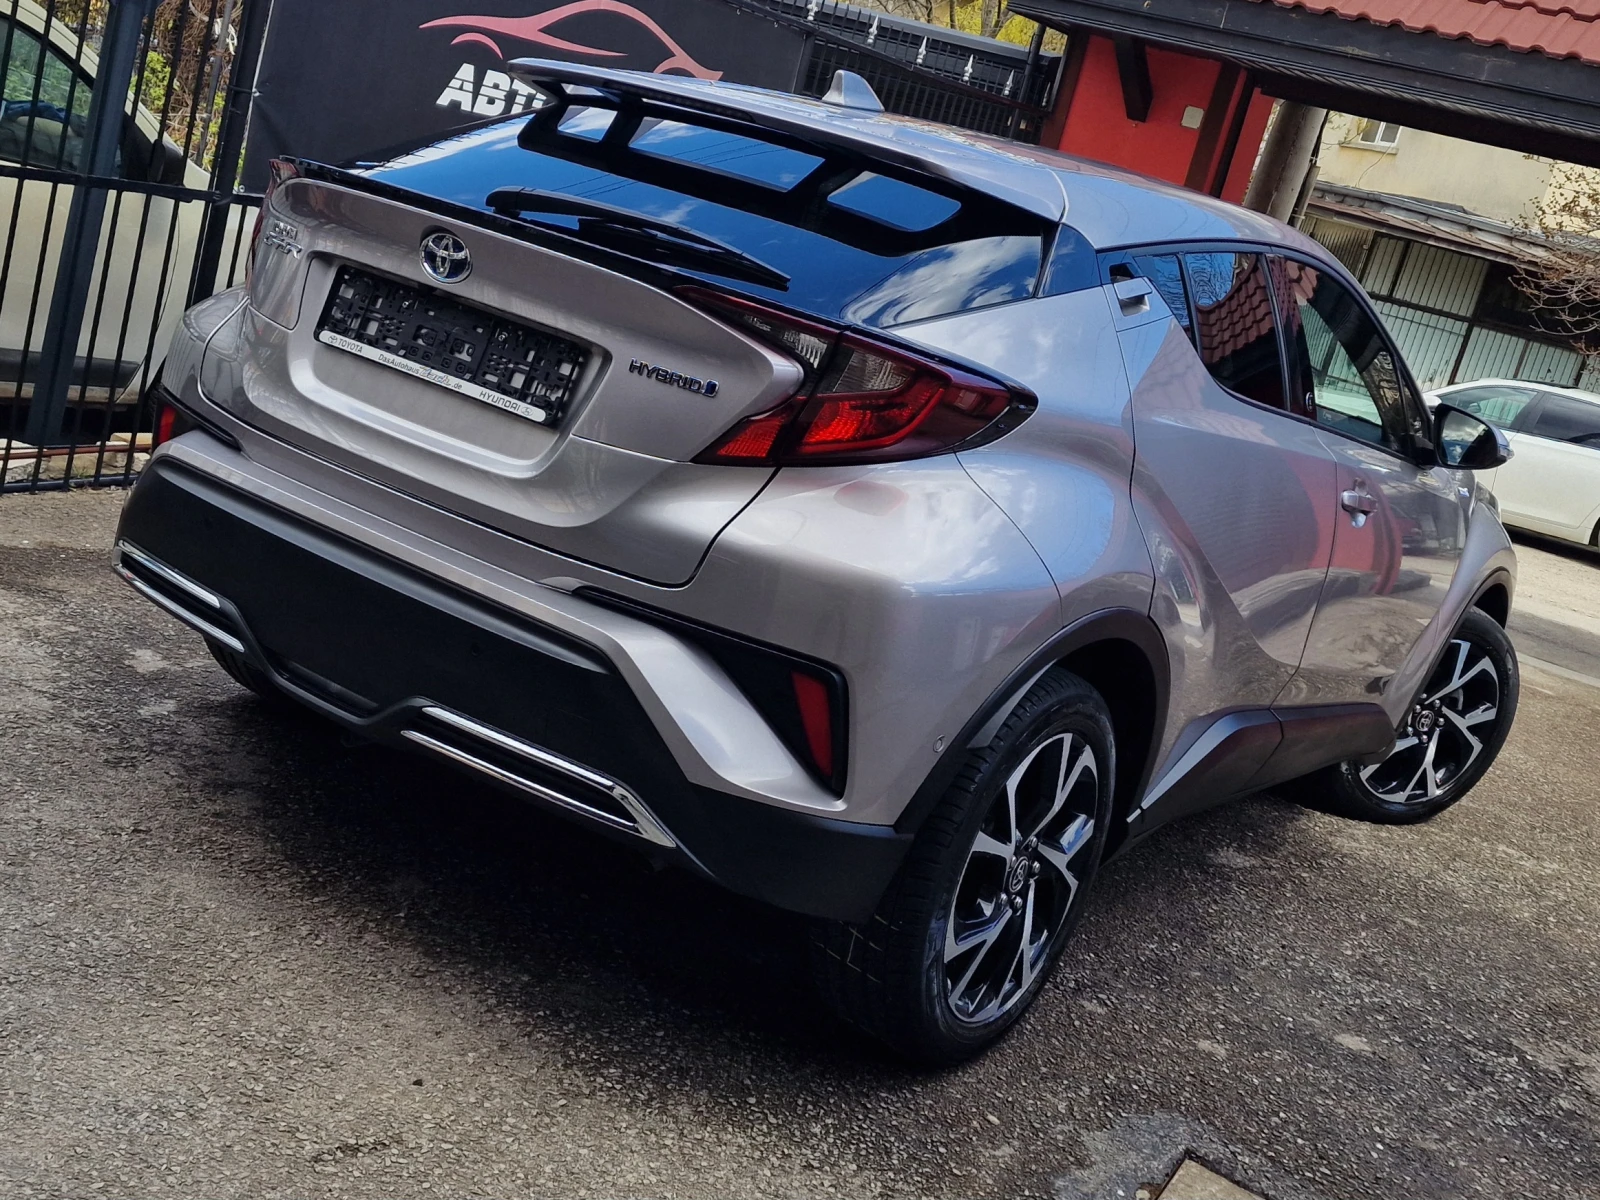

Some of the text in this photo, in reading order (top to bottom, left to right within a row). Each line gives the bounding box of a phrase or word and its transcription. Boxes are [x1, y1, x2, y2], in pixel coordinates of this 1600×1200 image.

[338, 337, 363, 353] TOYOTA
[628, 358, 704, 395] HYBRID
[478, 390, 521, 412] HYUNDAI
